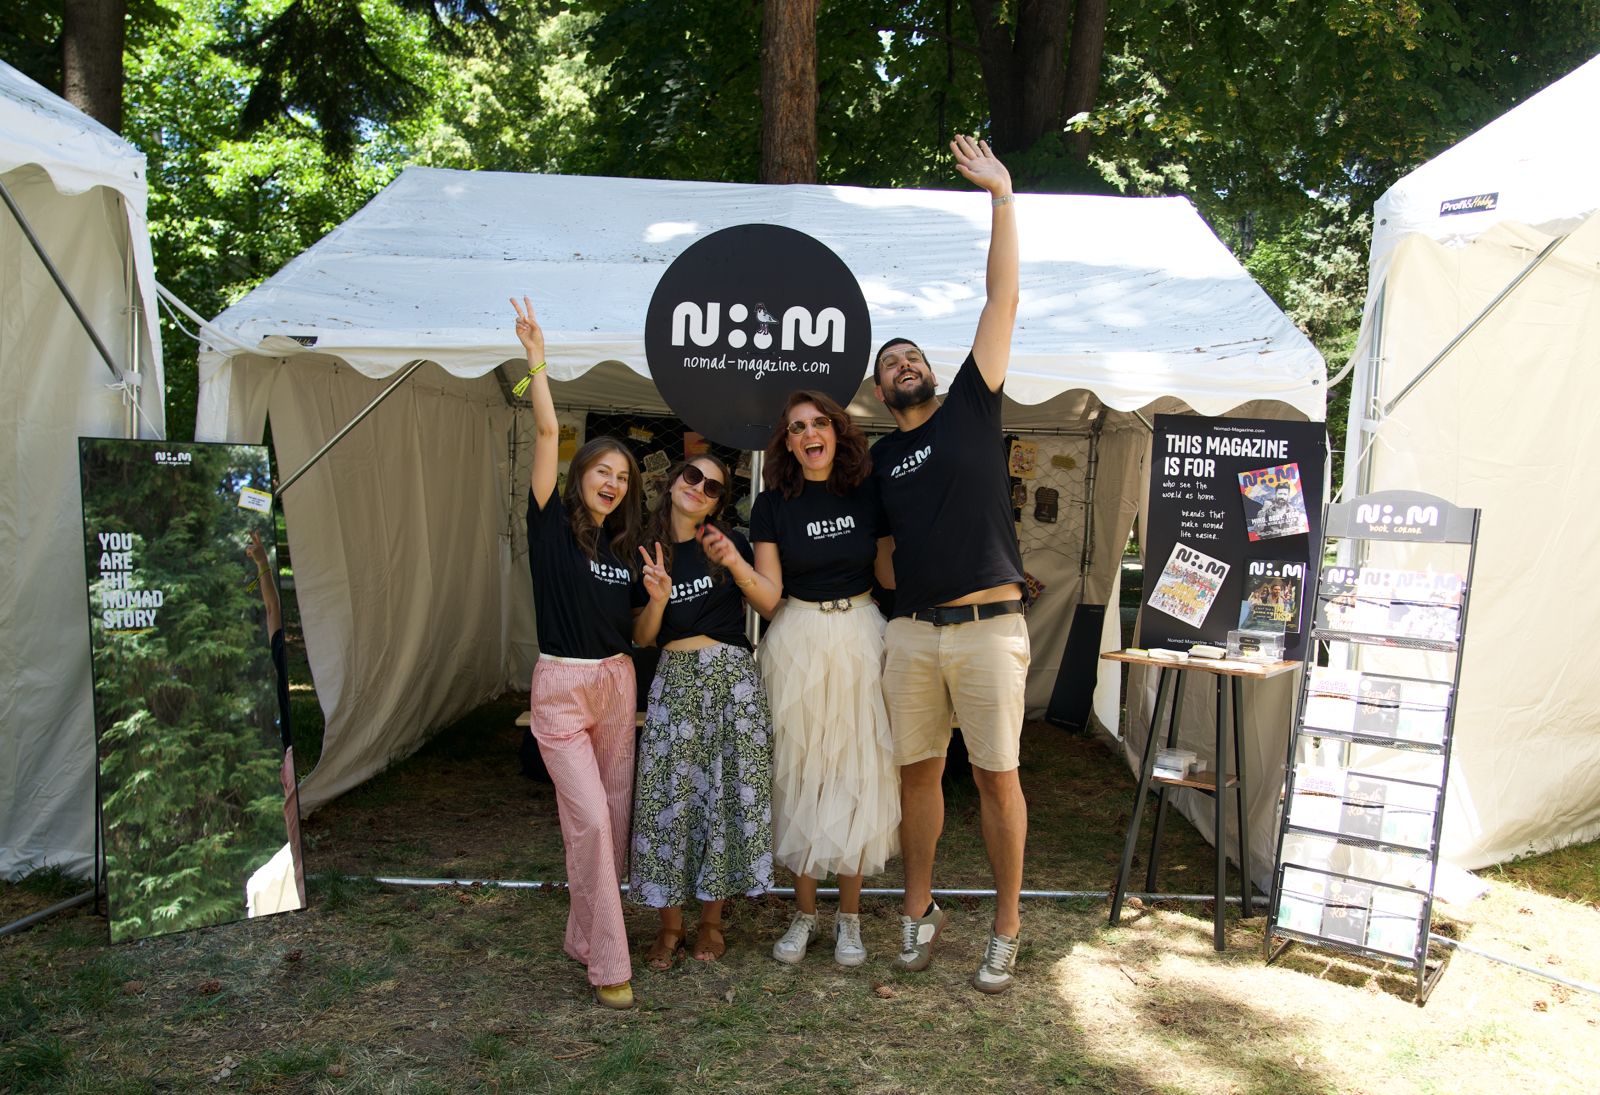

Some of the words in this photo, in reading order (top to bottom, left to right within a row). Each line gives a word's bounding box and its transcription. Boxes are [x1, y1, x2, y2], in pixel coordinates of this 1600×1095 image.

[683, 353, 830, 380] nomad-magazine.com
[1165, 434, 1202, 454] THIS
[1206, 436, 1289, 459] MAGAZINE
[1164, 456, 1180, 476] IS
[1184, 458, 1216, 478] FOR
[1162, 480, 1176, 488] who
[1196, 481, 1208, 490] the
[1162, 491, 1181, 499] world
[1198, 492, 1217, 501] home.
[1181, 510, 1205, 518] brands
[1209, 510, 1225, 519] that
[1181, 530, 1192, 538] life
[1369, 524, 1389, 533] book
[98, 532, 133, 551] YOU
[100, 551, 133, 570] ARE
[100, 571, 133, 590] THE
[102, 590, 164, 609] NOMAD
[103, 609, 157, 629] STORY
